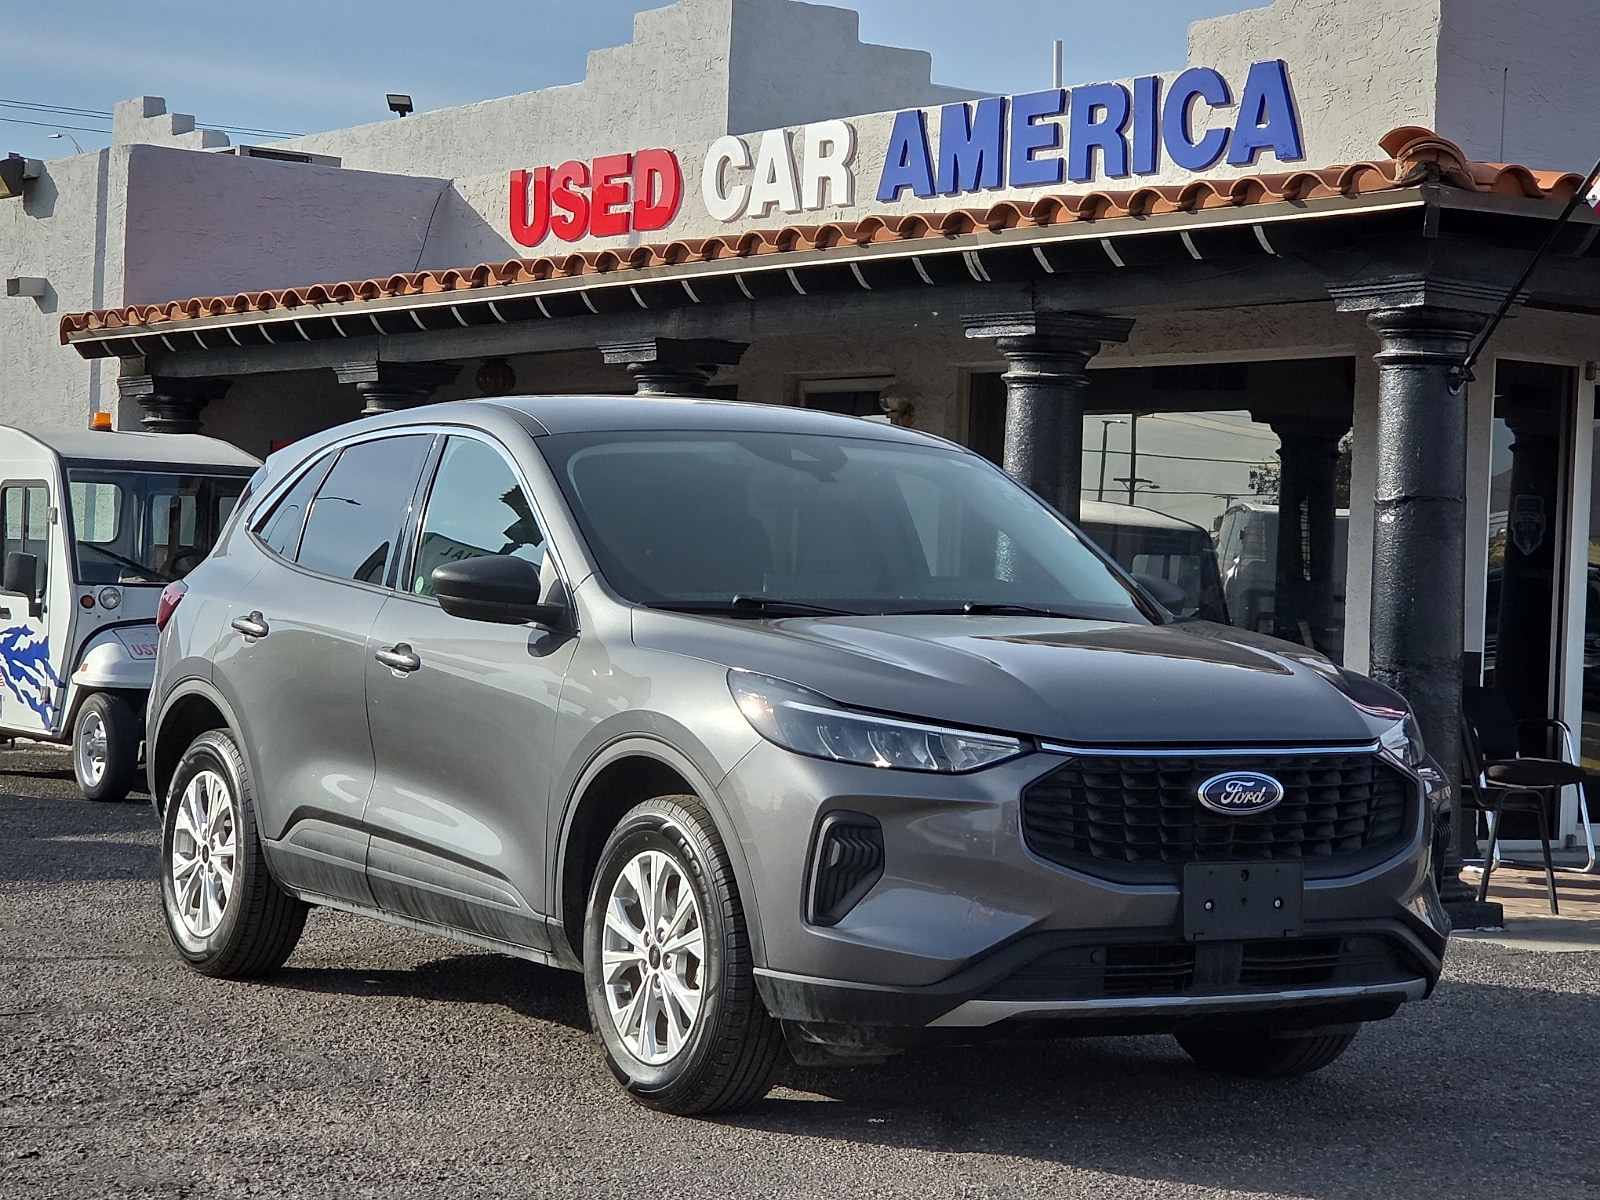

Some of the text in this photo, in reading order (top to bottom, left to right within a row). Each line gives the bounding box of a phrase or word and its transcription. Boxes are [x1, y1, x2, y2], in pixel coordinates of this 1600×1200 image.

[509, 59, 1304, 247] USED CAR AMERICA
[1220, 780, 1267, 804] Ford
